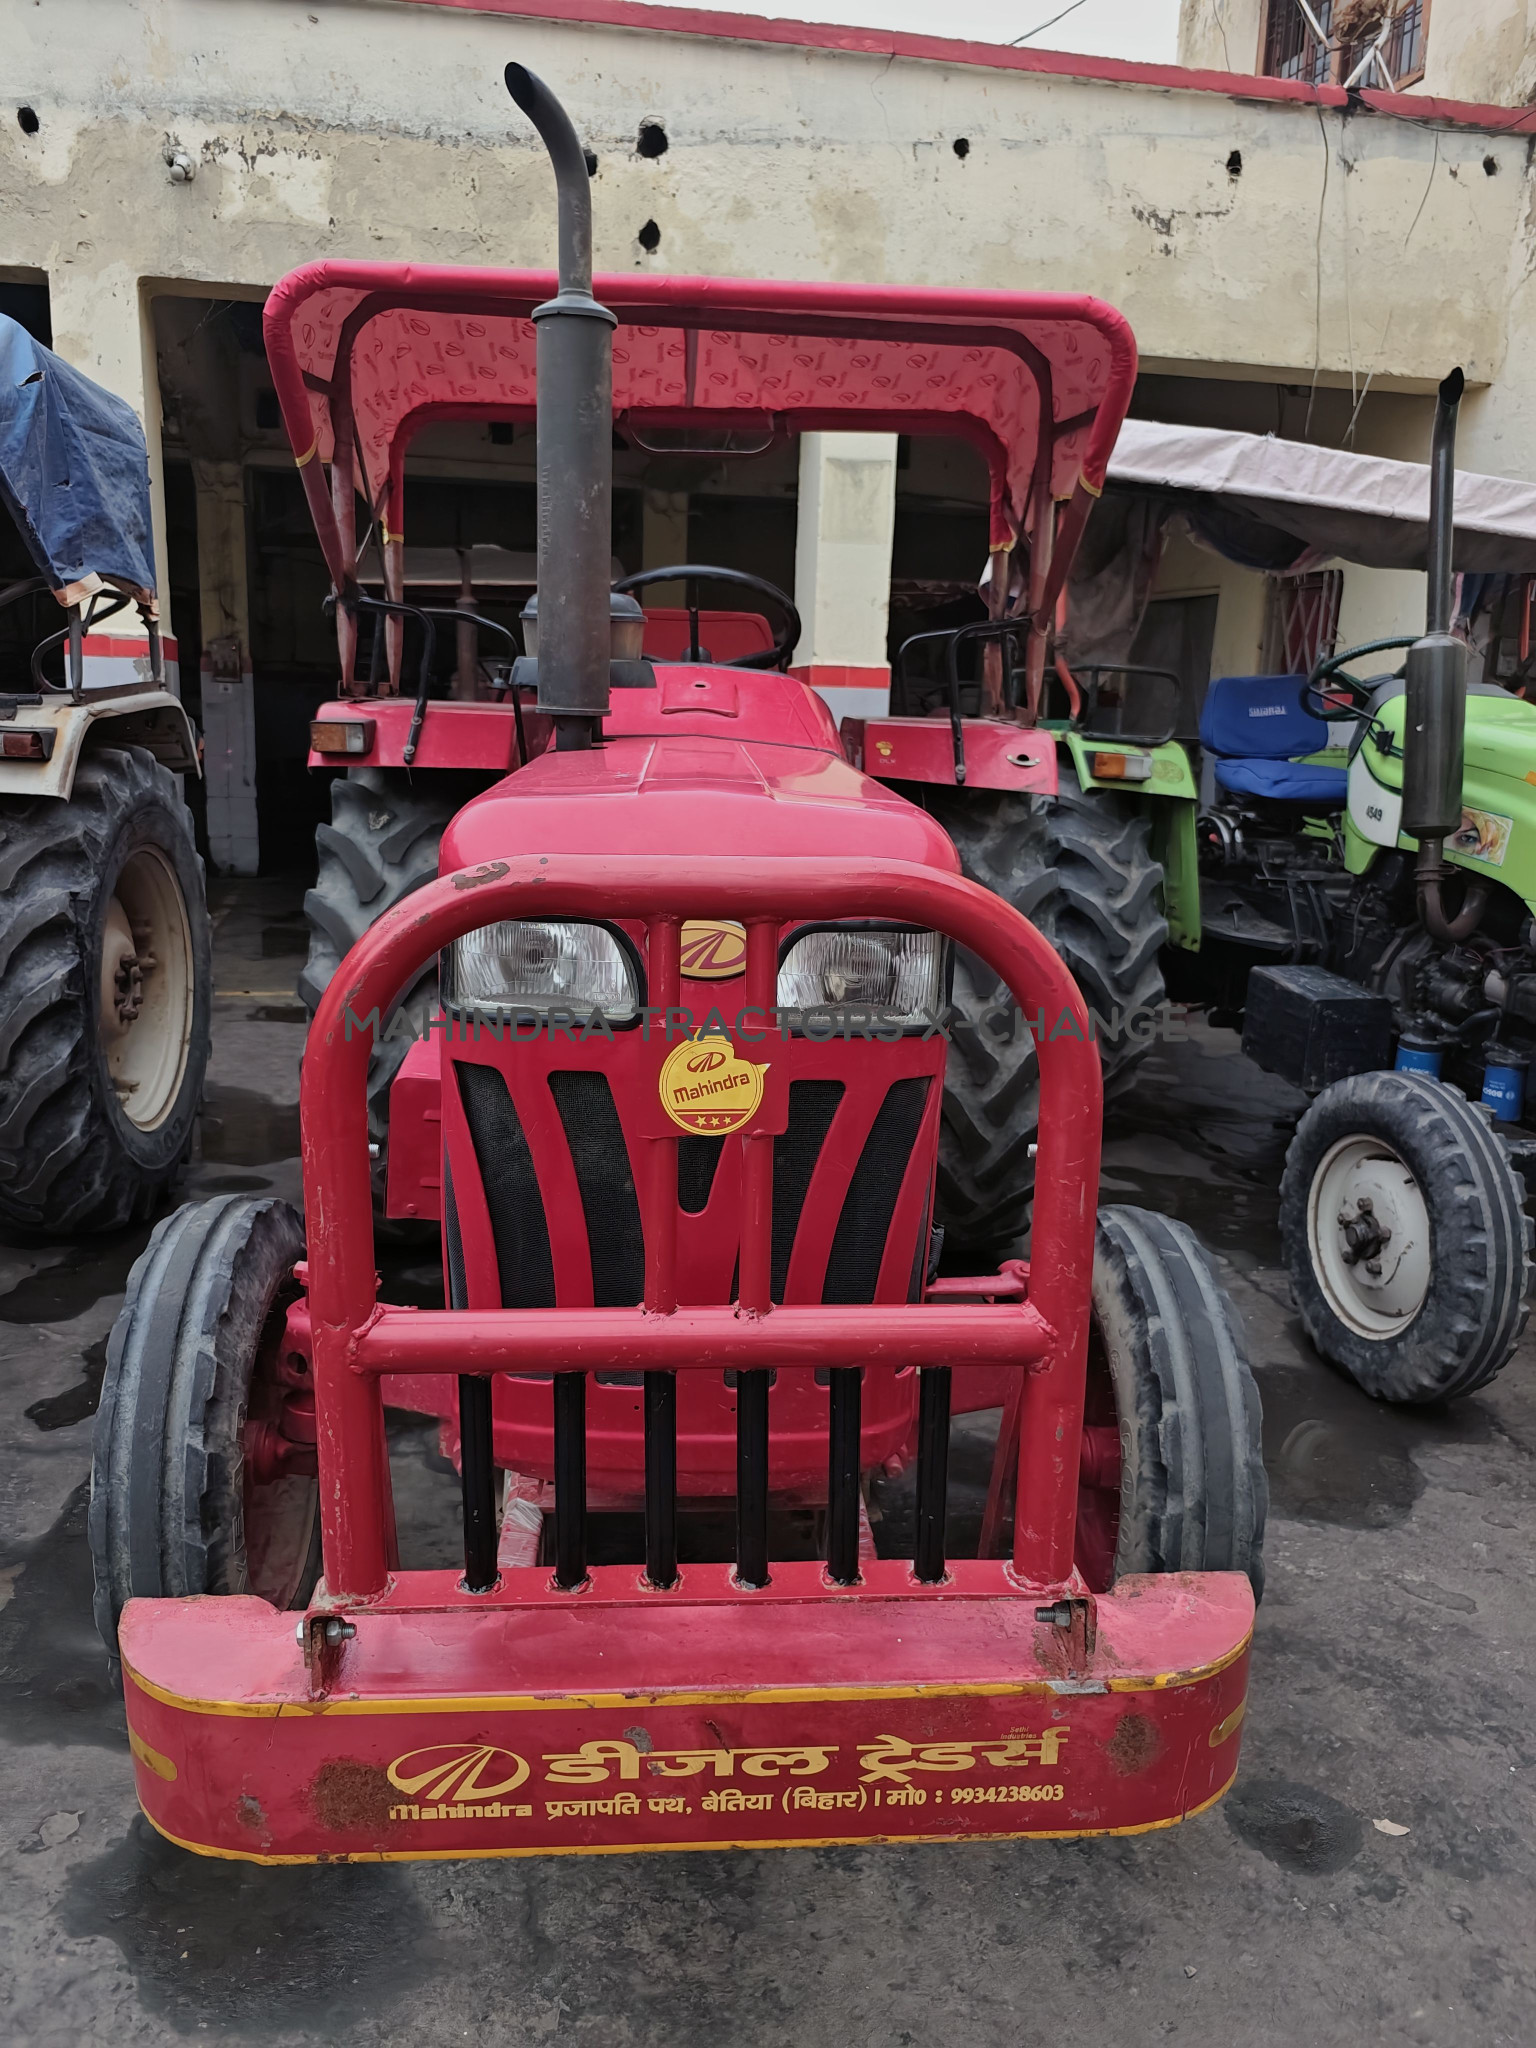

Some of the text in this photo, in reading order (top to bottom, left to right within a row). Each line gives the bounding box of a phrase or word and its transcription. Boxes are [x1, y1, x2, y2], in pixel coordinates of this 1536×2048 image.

[673, 1073, 751, 1104] Mahindra
[1000, 1732, 1037, 1740] Industries
[542, 1726, 1071, 1784] डीजल ट्रेडर्स
[389, 1802, 533, 1820] Mahindra
[545, 1792, 641, 1821] प्रजापति
[701, 1788, 773, 1812] बेतिया
[951, 1784, 1065, 1804] 9934238603
